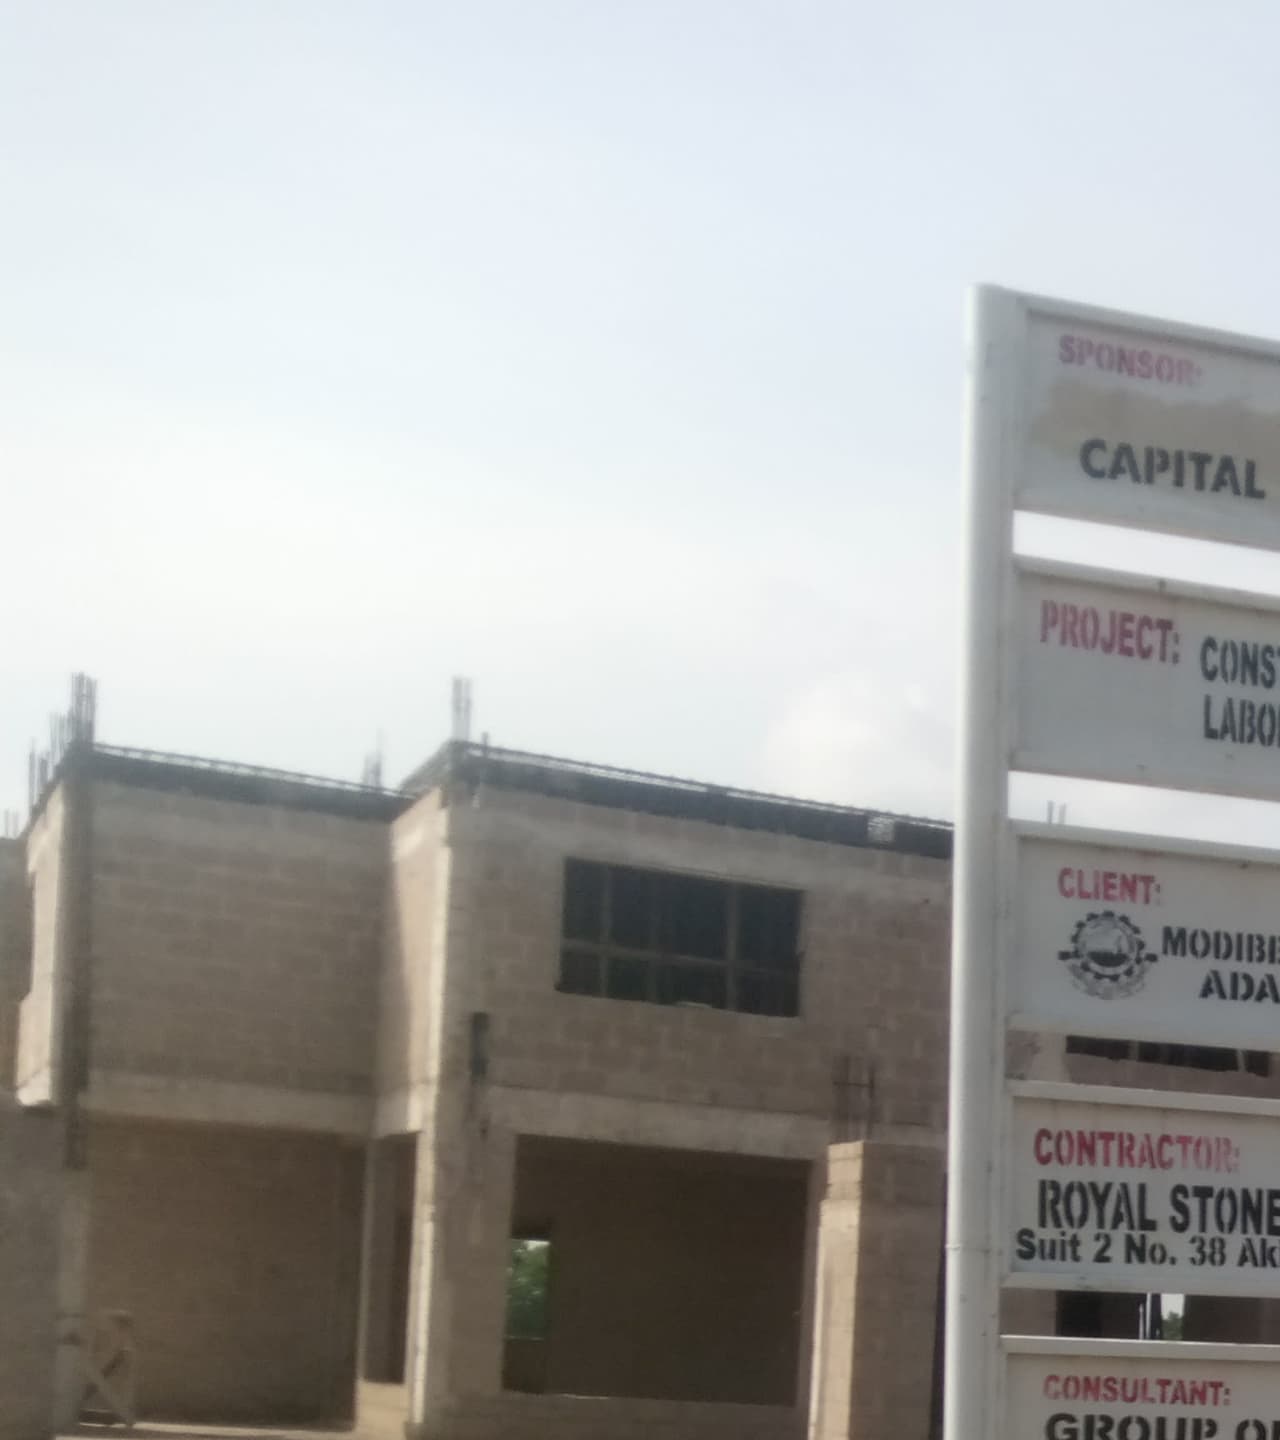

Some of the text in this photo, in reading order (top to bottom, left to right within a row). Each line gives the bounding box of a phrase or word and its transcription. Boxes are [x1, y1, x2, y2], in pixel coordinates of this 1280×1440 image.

[1079, 438, 1266, 500] CAPITAL
[1040, 600, 1180, 664] PROJECT:
[1058, 867, 1161, 906] CLIENT:
[1034, 1128, 1240, 1173] CONTRACTOR:
[1037, 1179, 1157, 1232] ROYAL
[1016, 1228, 1081, 1263] Suit
[1092, 1233, 1113, 1264] 2
[1124, 1232, 1178, 1266] No.
[1189, 1235, 1227, 1268] 38
[1043, 1374, 1231, 1406] CONSULTANT:
